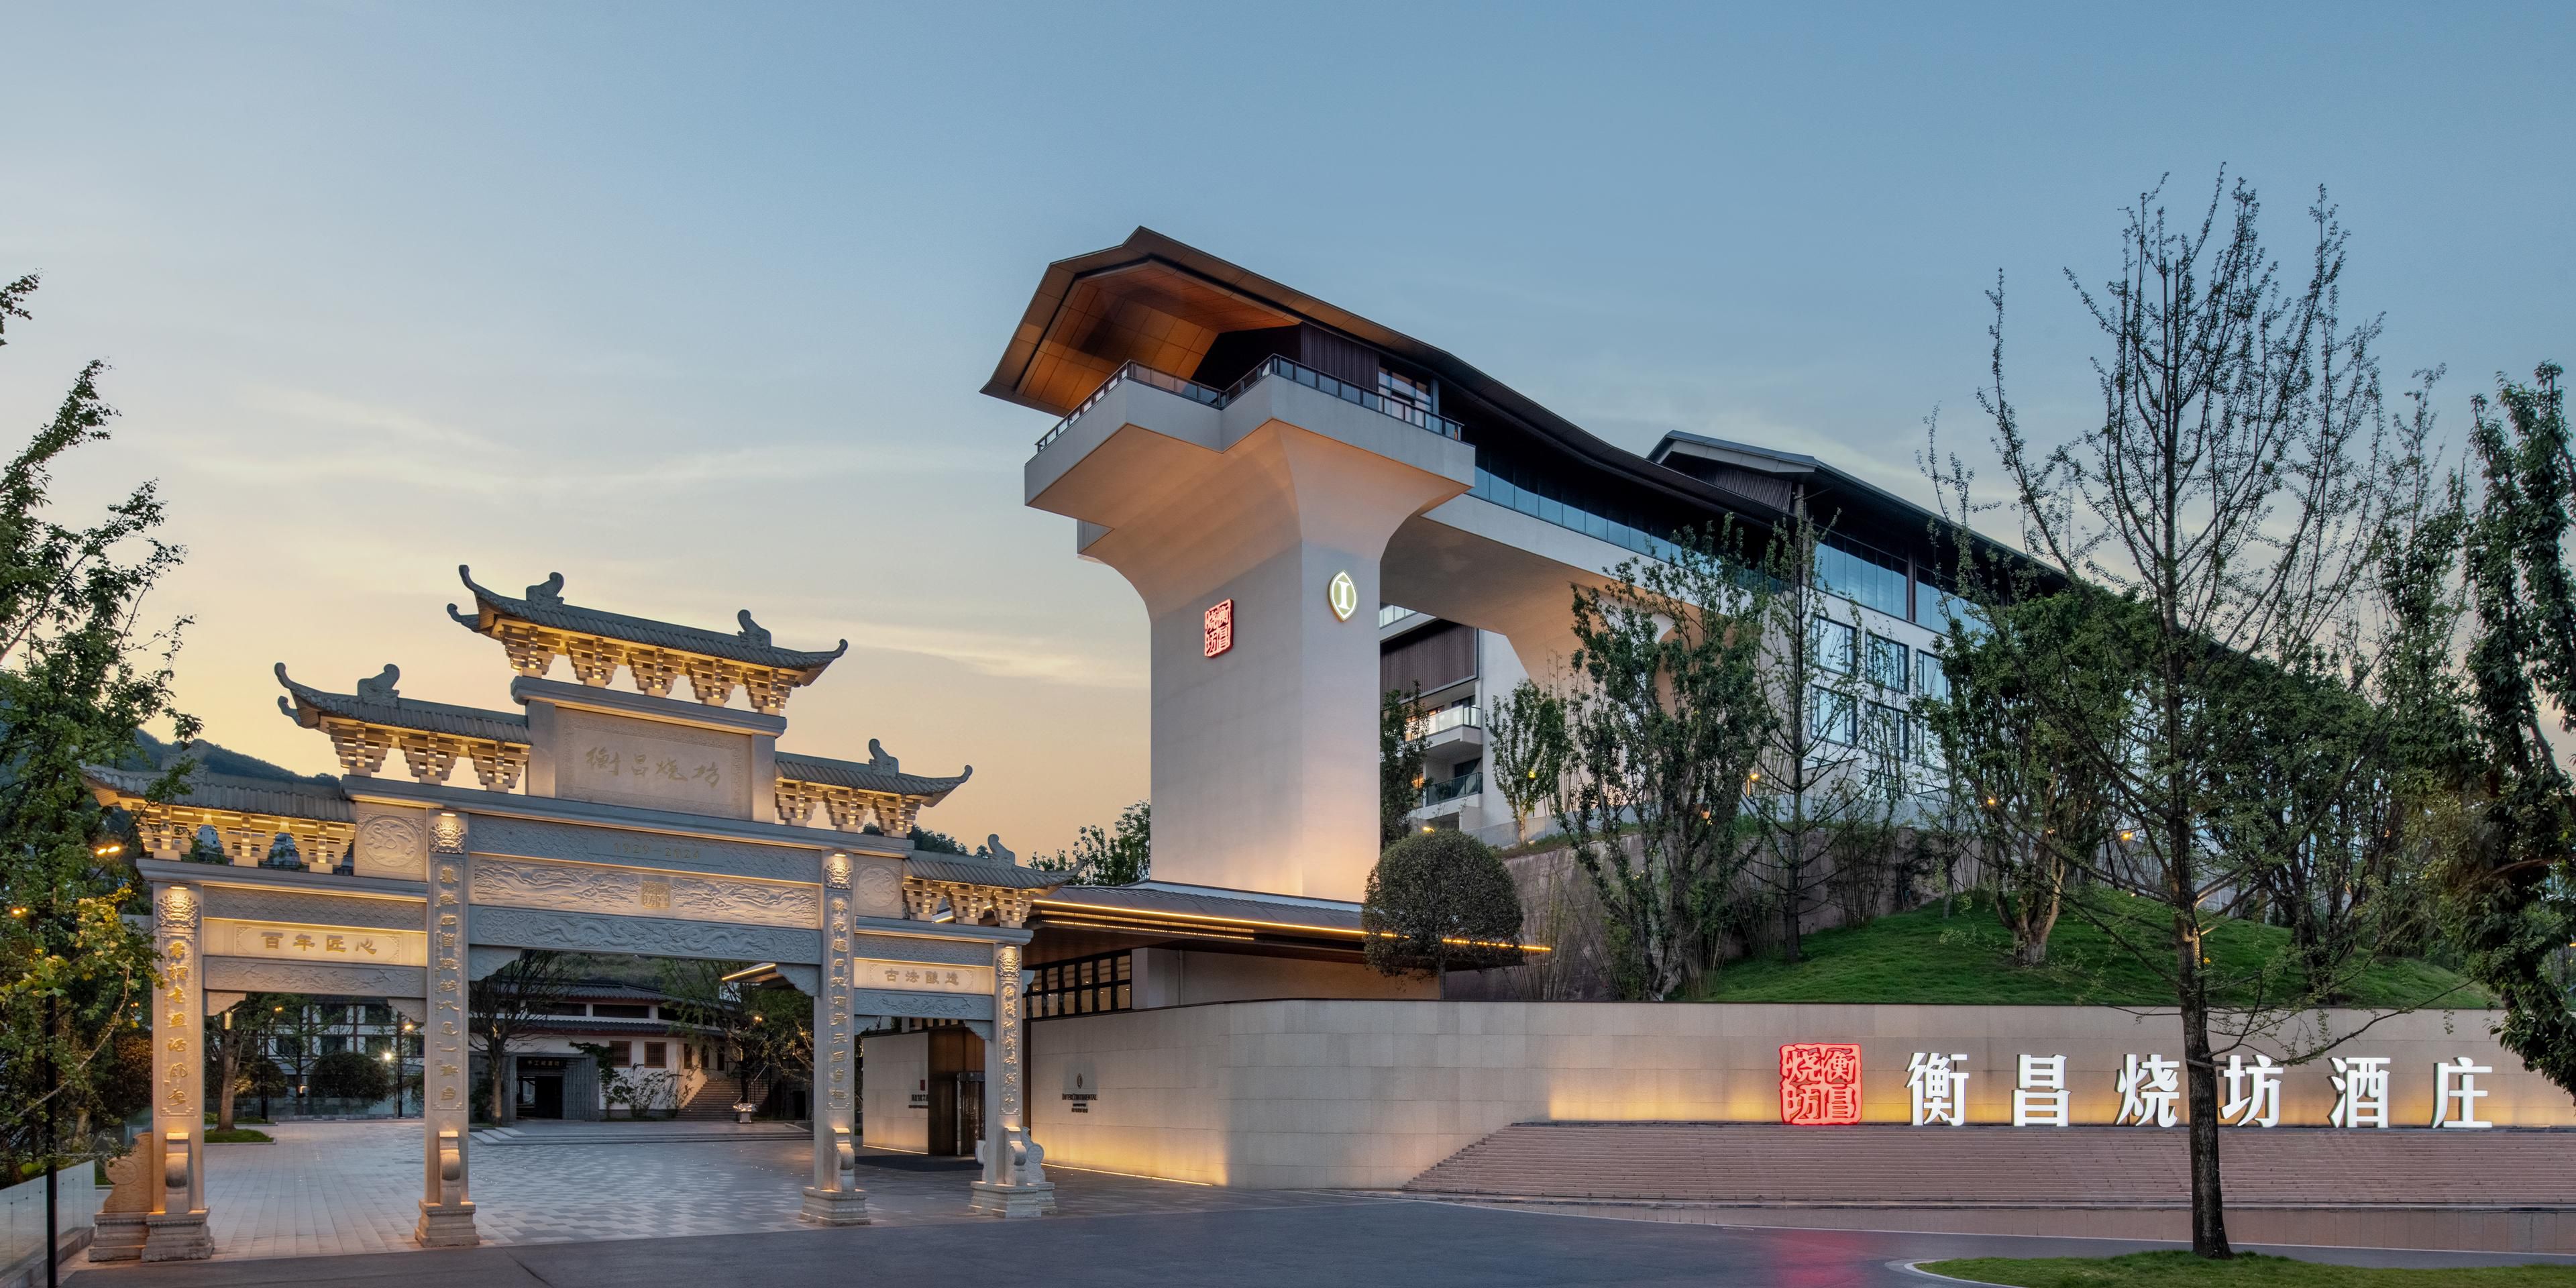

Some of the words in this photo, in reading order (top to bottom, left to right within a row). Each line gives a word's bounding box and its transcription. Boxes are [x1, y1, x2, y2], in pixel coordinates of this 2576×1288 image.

[586, 746, 720, 788] 衡昌烧坊
[261, 932, 377, 955] 百年匠心
[884, 968, 959, 986] 古法酿造
[1905, 1052, 2493, 1128] 衡昌烧坊酒庄
